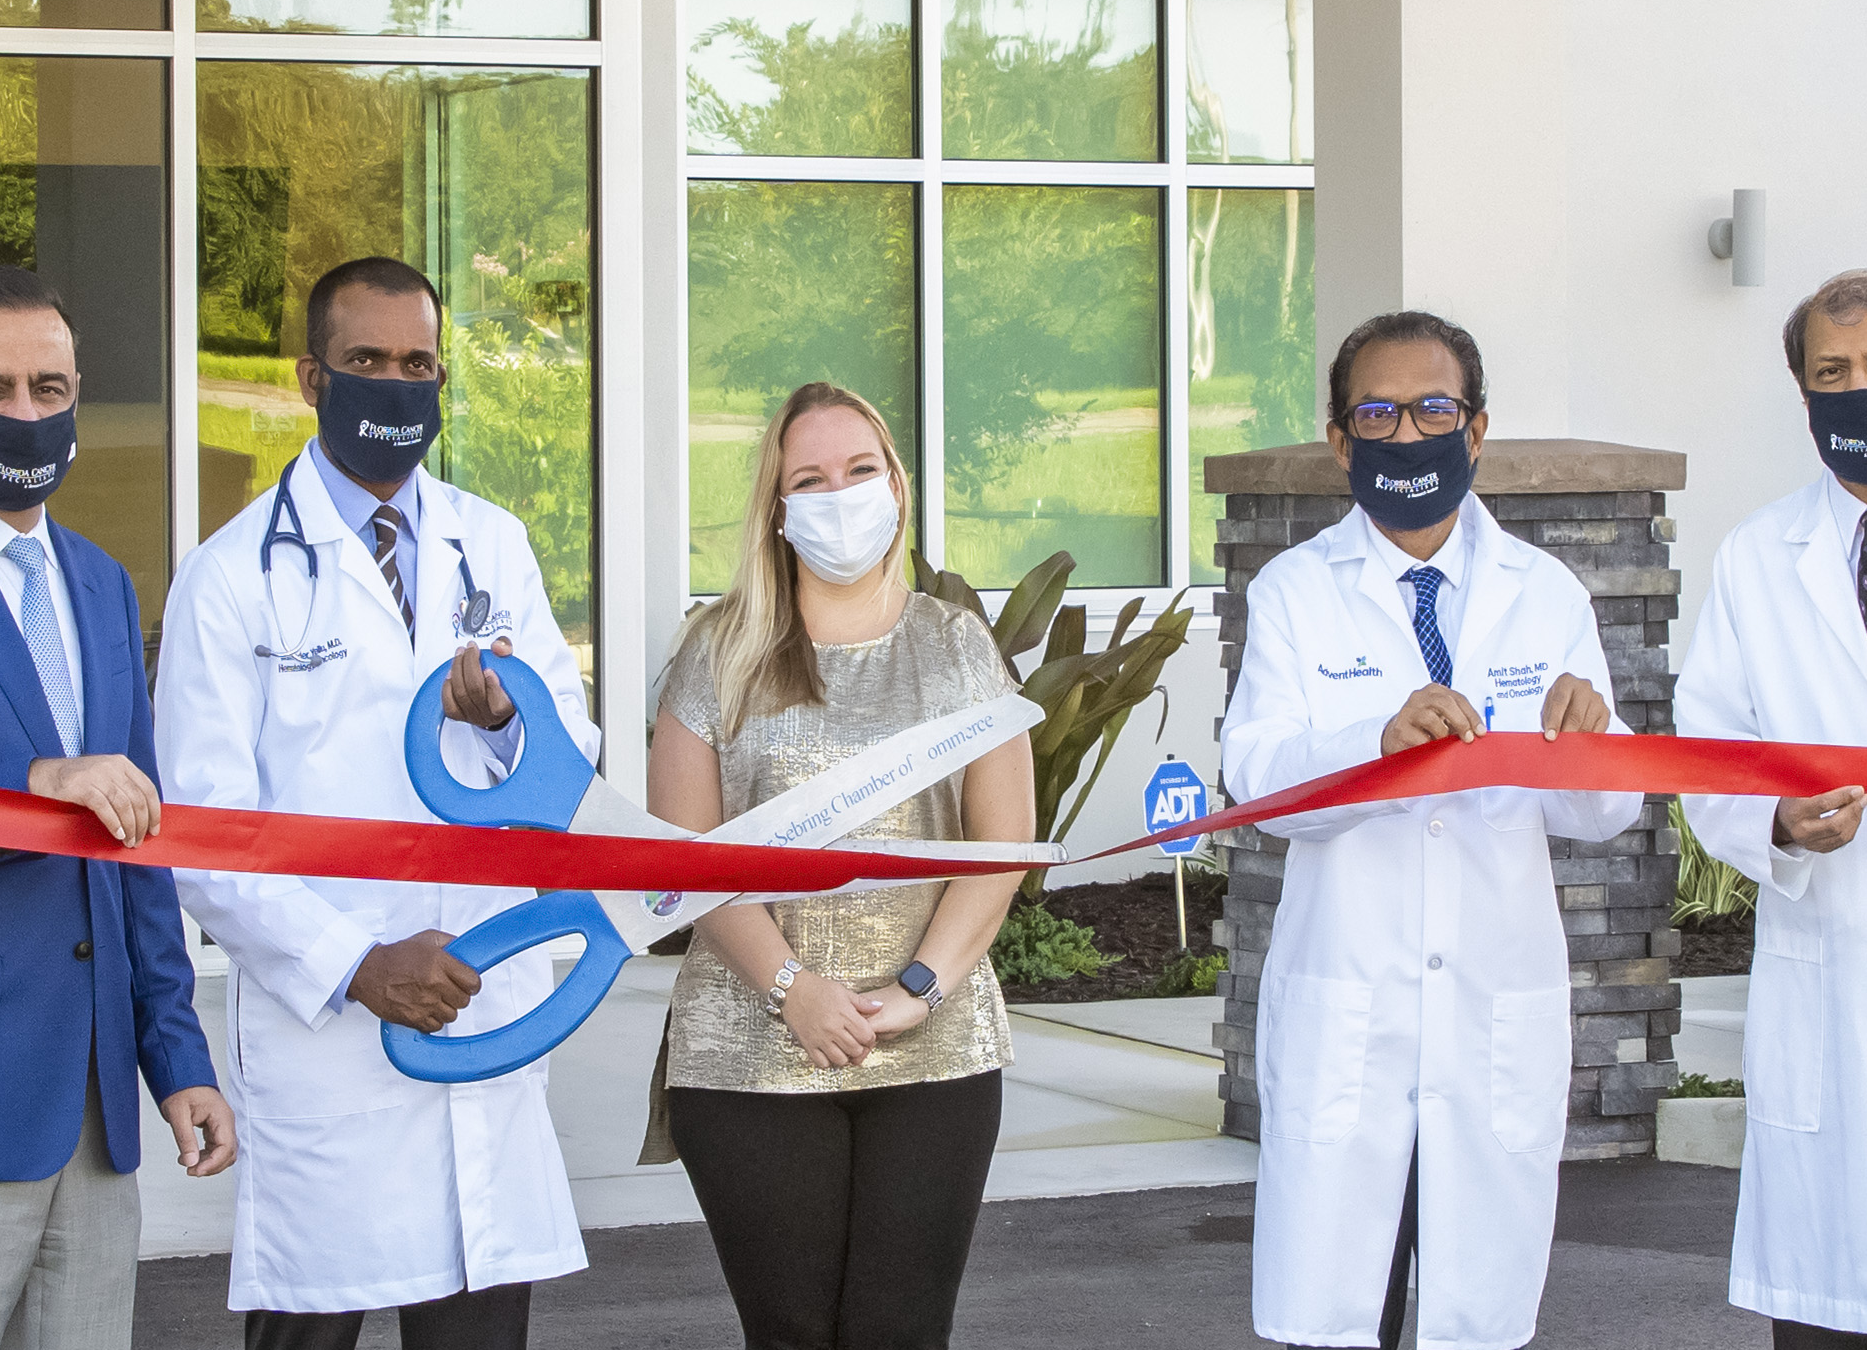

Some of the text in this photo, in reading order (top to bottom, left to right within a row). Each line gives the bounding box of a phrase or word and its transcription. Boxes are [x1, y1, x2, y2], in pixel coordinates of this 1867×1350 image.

[1534, 662, 1549, 672] MD
[1494, 674, 1542, 688] Hematology
[1508, 685, 1545, 699] Oncology
[774, 714, 994, 848] Sebring Chamber of ommerce
[1151, 785, 1201, 825] ADT
